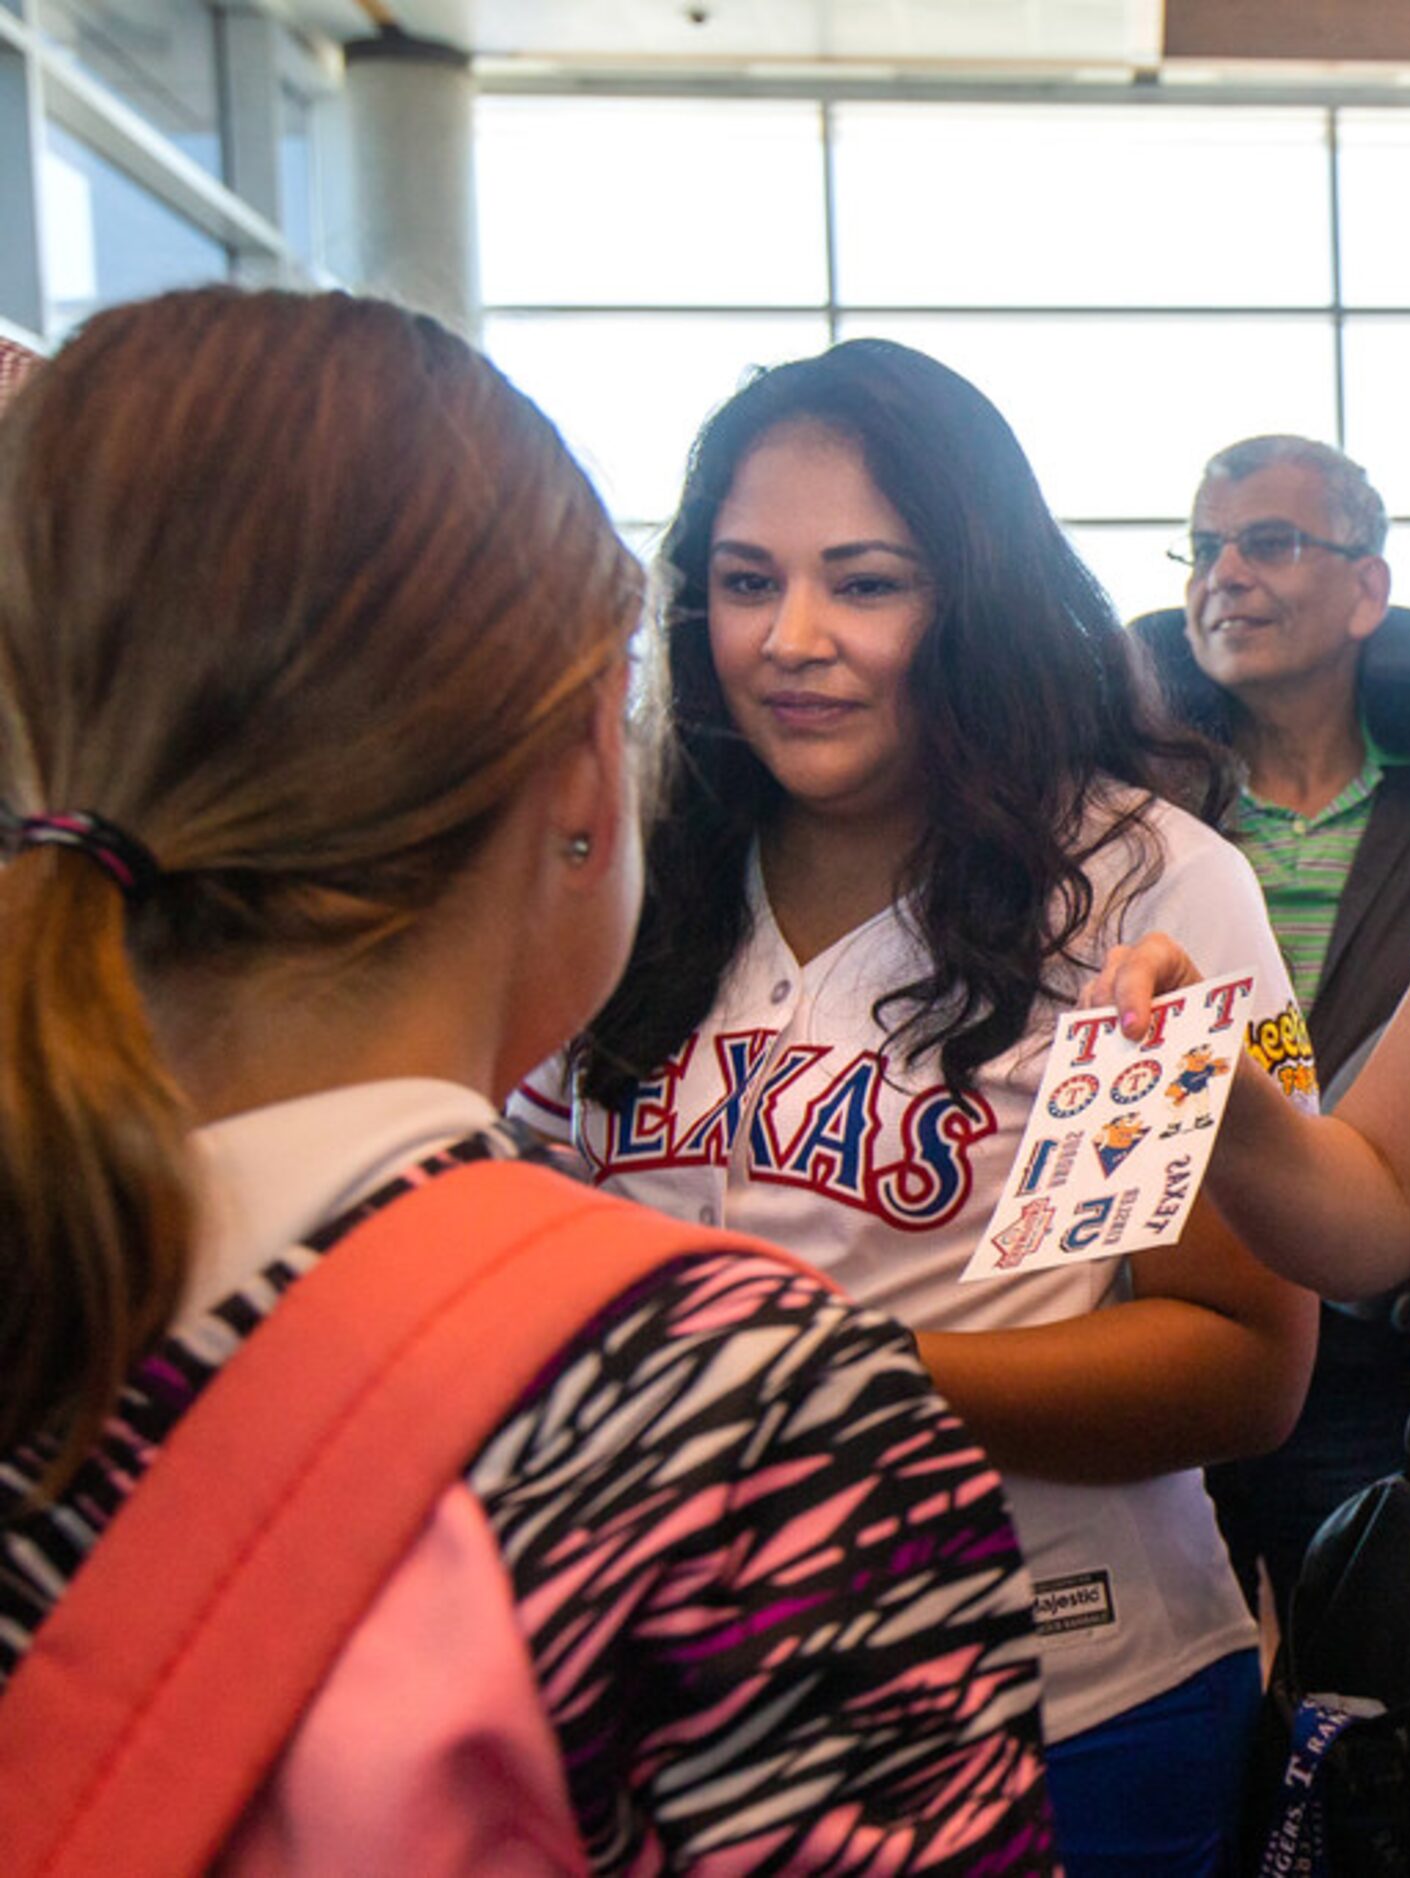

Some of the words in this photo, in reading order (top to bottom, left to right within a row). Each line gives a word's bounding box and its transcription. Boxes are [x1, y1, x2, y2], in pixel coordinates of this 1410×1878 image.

[1204, 977, 1254, 1034] T
[1065, 1015, 1118, 1067] T
[607, 1028, 998, 1232] EXAS
